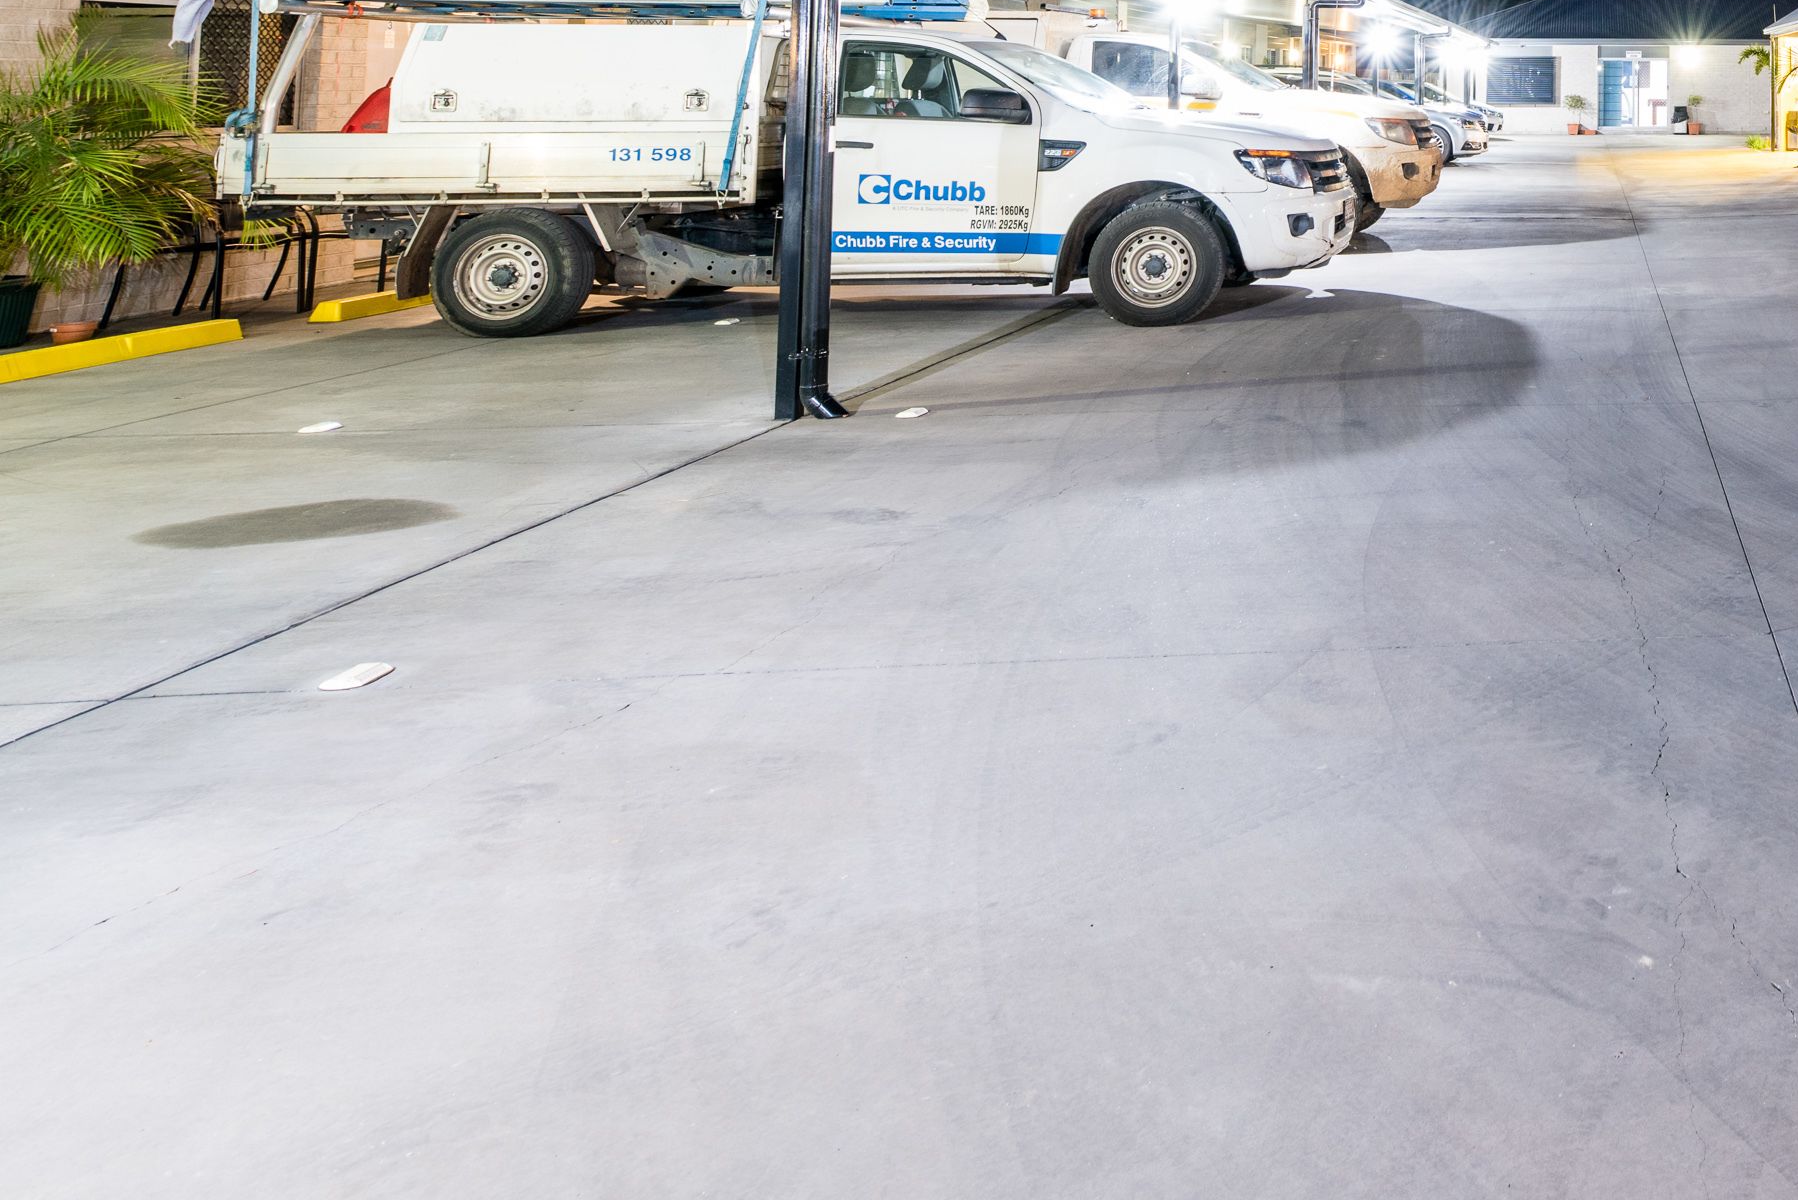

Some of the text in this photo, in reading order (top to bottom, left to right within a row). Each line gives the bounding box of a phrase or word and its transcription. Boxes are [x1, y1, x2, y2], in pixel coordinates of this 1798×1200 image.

[608, 148, 692, 161] 131 598
[892, 179, 986, 202] Chubb
[974, 205, 1030, 218] TARE: 1860Kg
[970, 219, 1029, 232] RGVM: 2925Kg
[834, 234, 997, 251] Chubb Fire & Security
